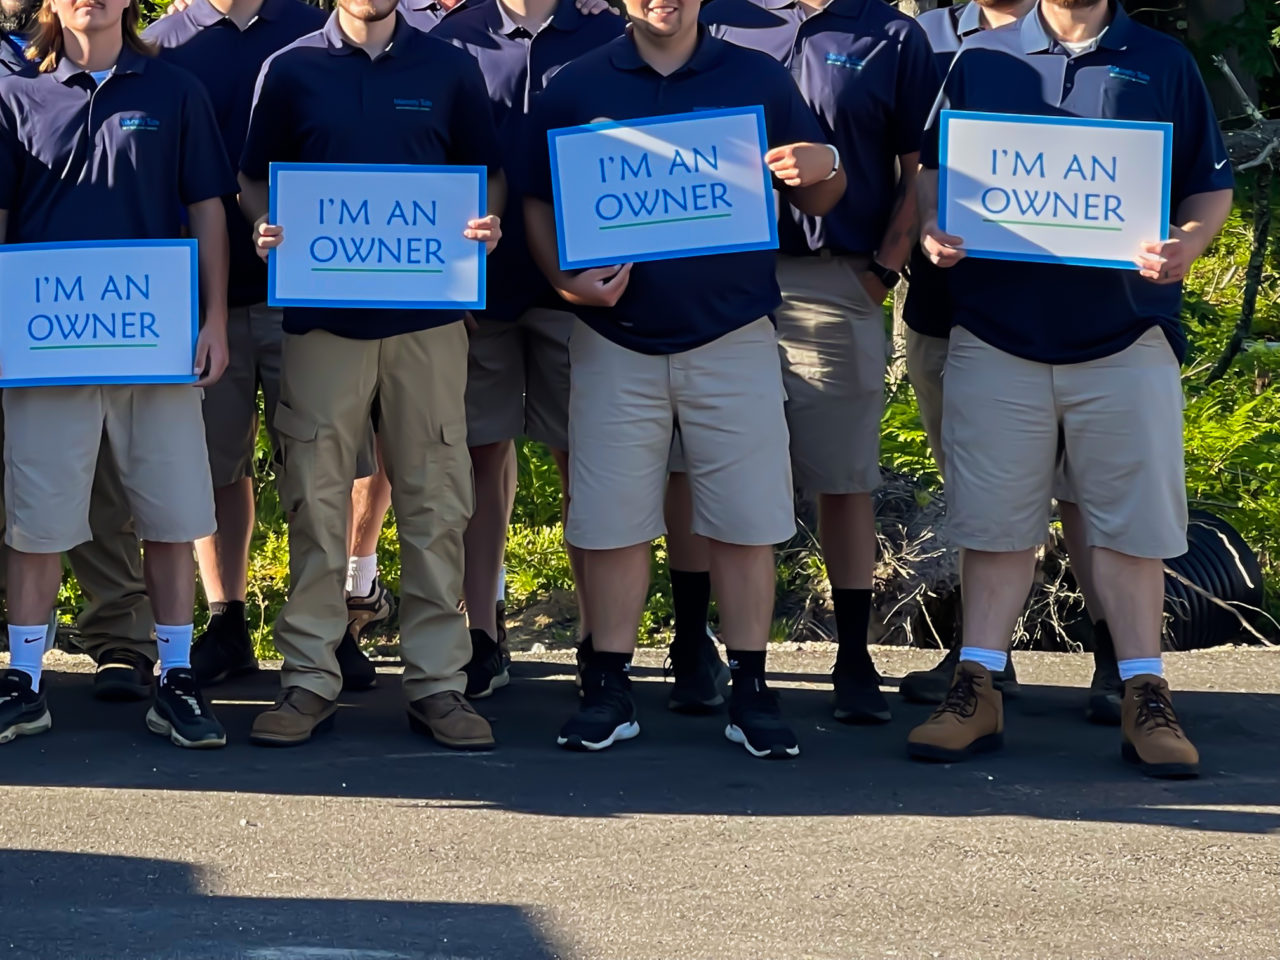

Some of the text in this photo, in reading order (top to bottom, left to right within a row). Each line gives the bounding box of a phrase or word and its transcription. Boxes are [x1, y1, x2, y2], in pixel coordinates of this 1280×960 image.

[598, 144, 719, 184] I'M AN
[991, 148, 1118, 183] I'M AN
[318, 197, 437, 227] I'M AN
[593, 181, 733, 222] OWNER
[977, 185, 1126, 223] OWNER
[309, 235, 446, 265] OWNER
[34, 273, 150, 304] I'M AN
[27, 311, 161, 342] OWNER
